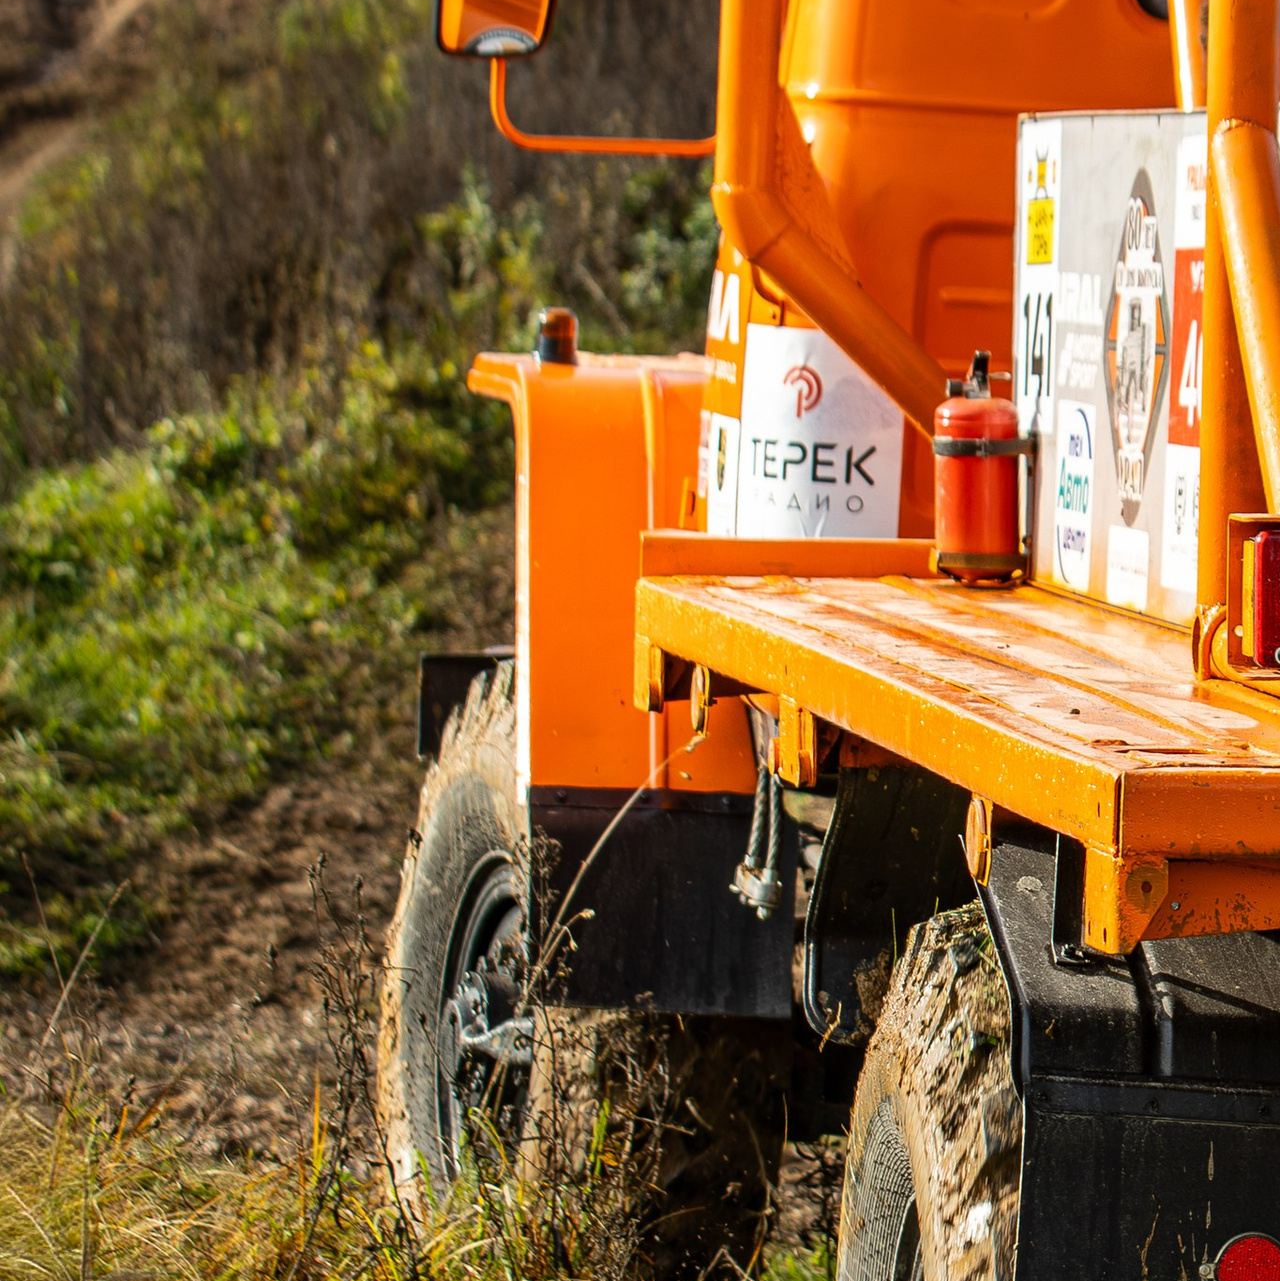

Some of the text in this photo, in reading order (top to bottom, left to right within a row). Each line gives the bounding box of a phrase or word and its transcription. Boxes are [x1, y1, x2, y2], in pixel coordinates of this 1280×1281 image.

[1127, 205, 1141, 250] 80
[1023, 291, 1053, 397] 141
[752, 437, 877, 487] ТЕРЕК
[752, 488, 865, 514] АДИО
